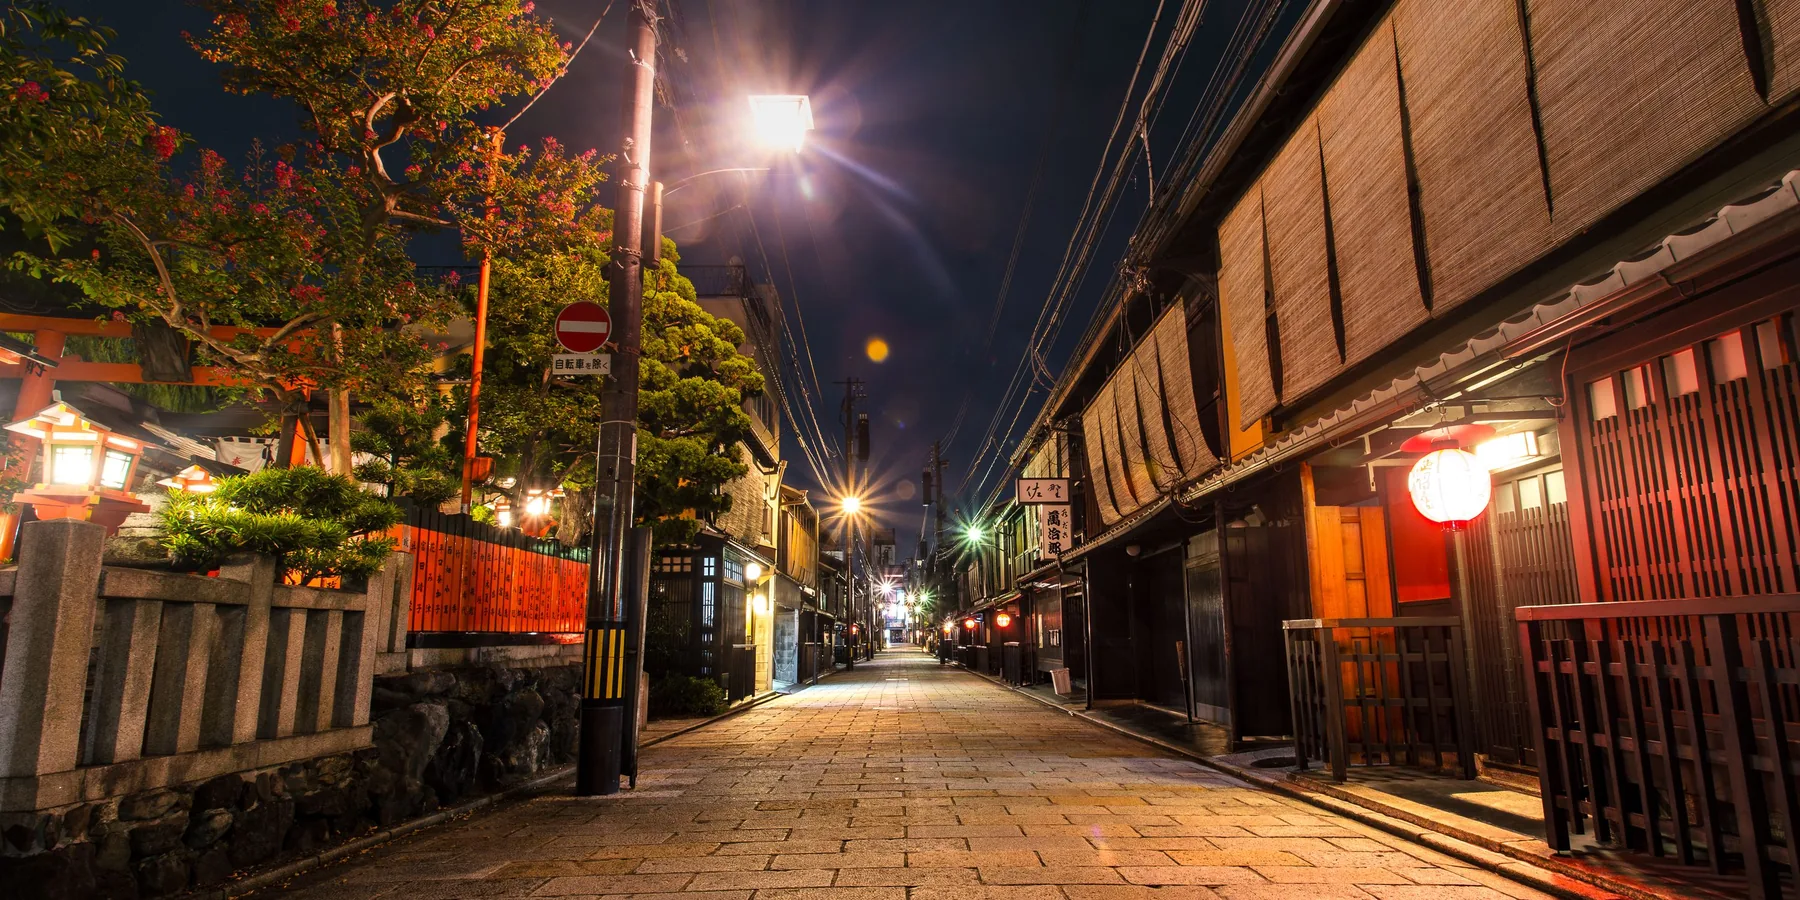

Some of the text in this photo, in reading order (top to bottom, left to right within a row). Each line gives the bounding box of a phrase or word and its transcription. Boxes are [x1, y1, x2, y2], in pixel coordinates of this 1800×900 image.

[555, 358, 608, 370] 自転車を除く
[1047, 510, 1062, 555] 萬治郎
